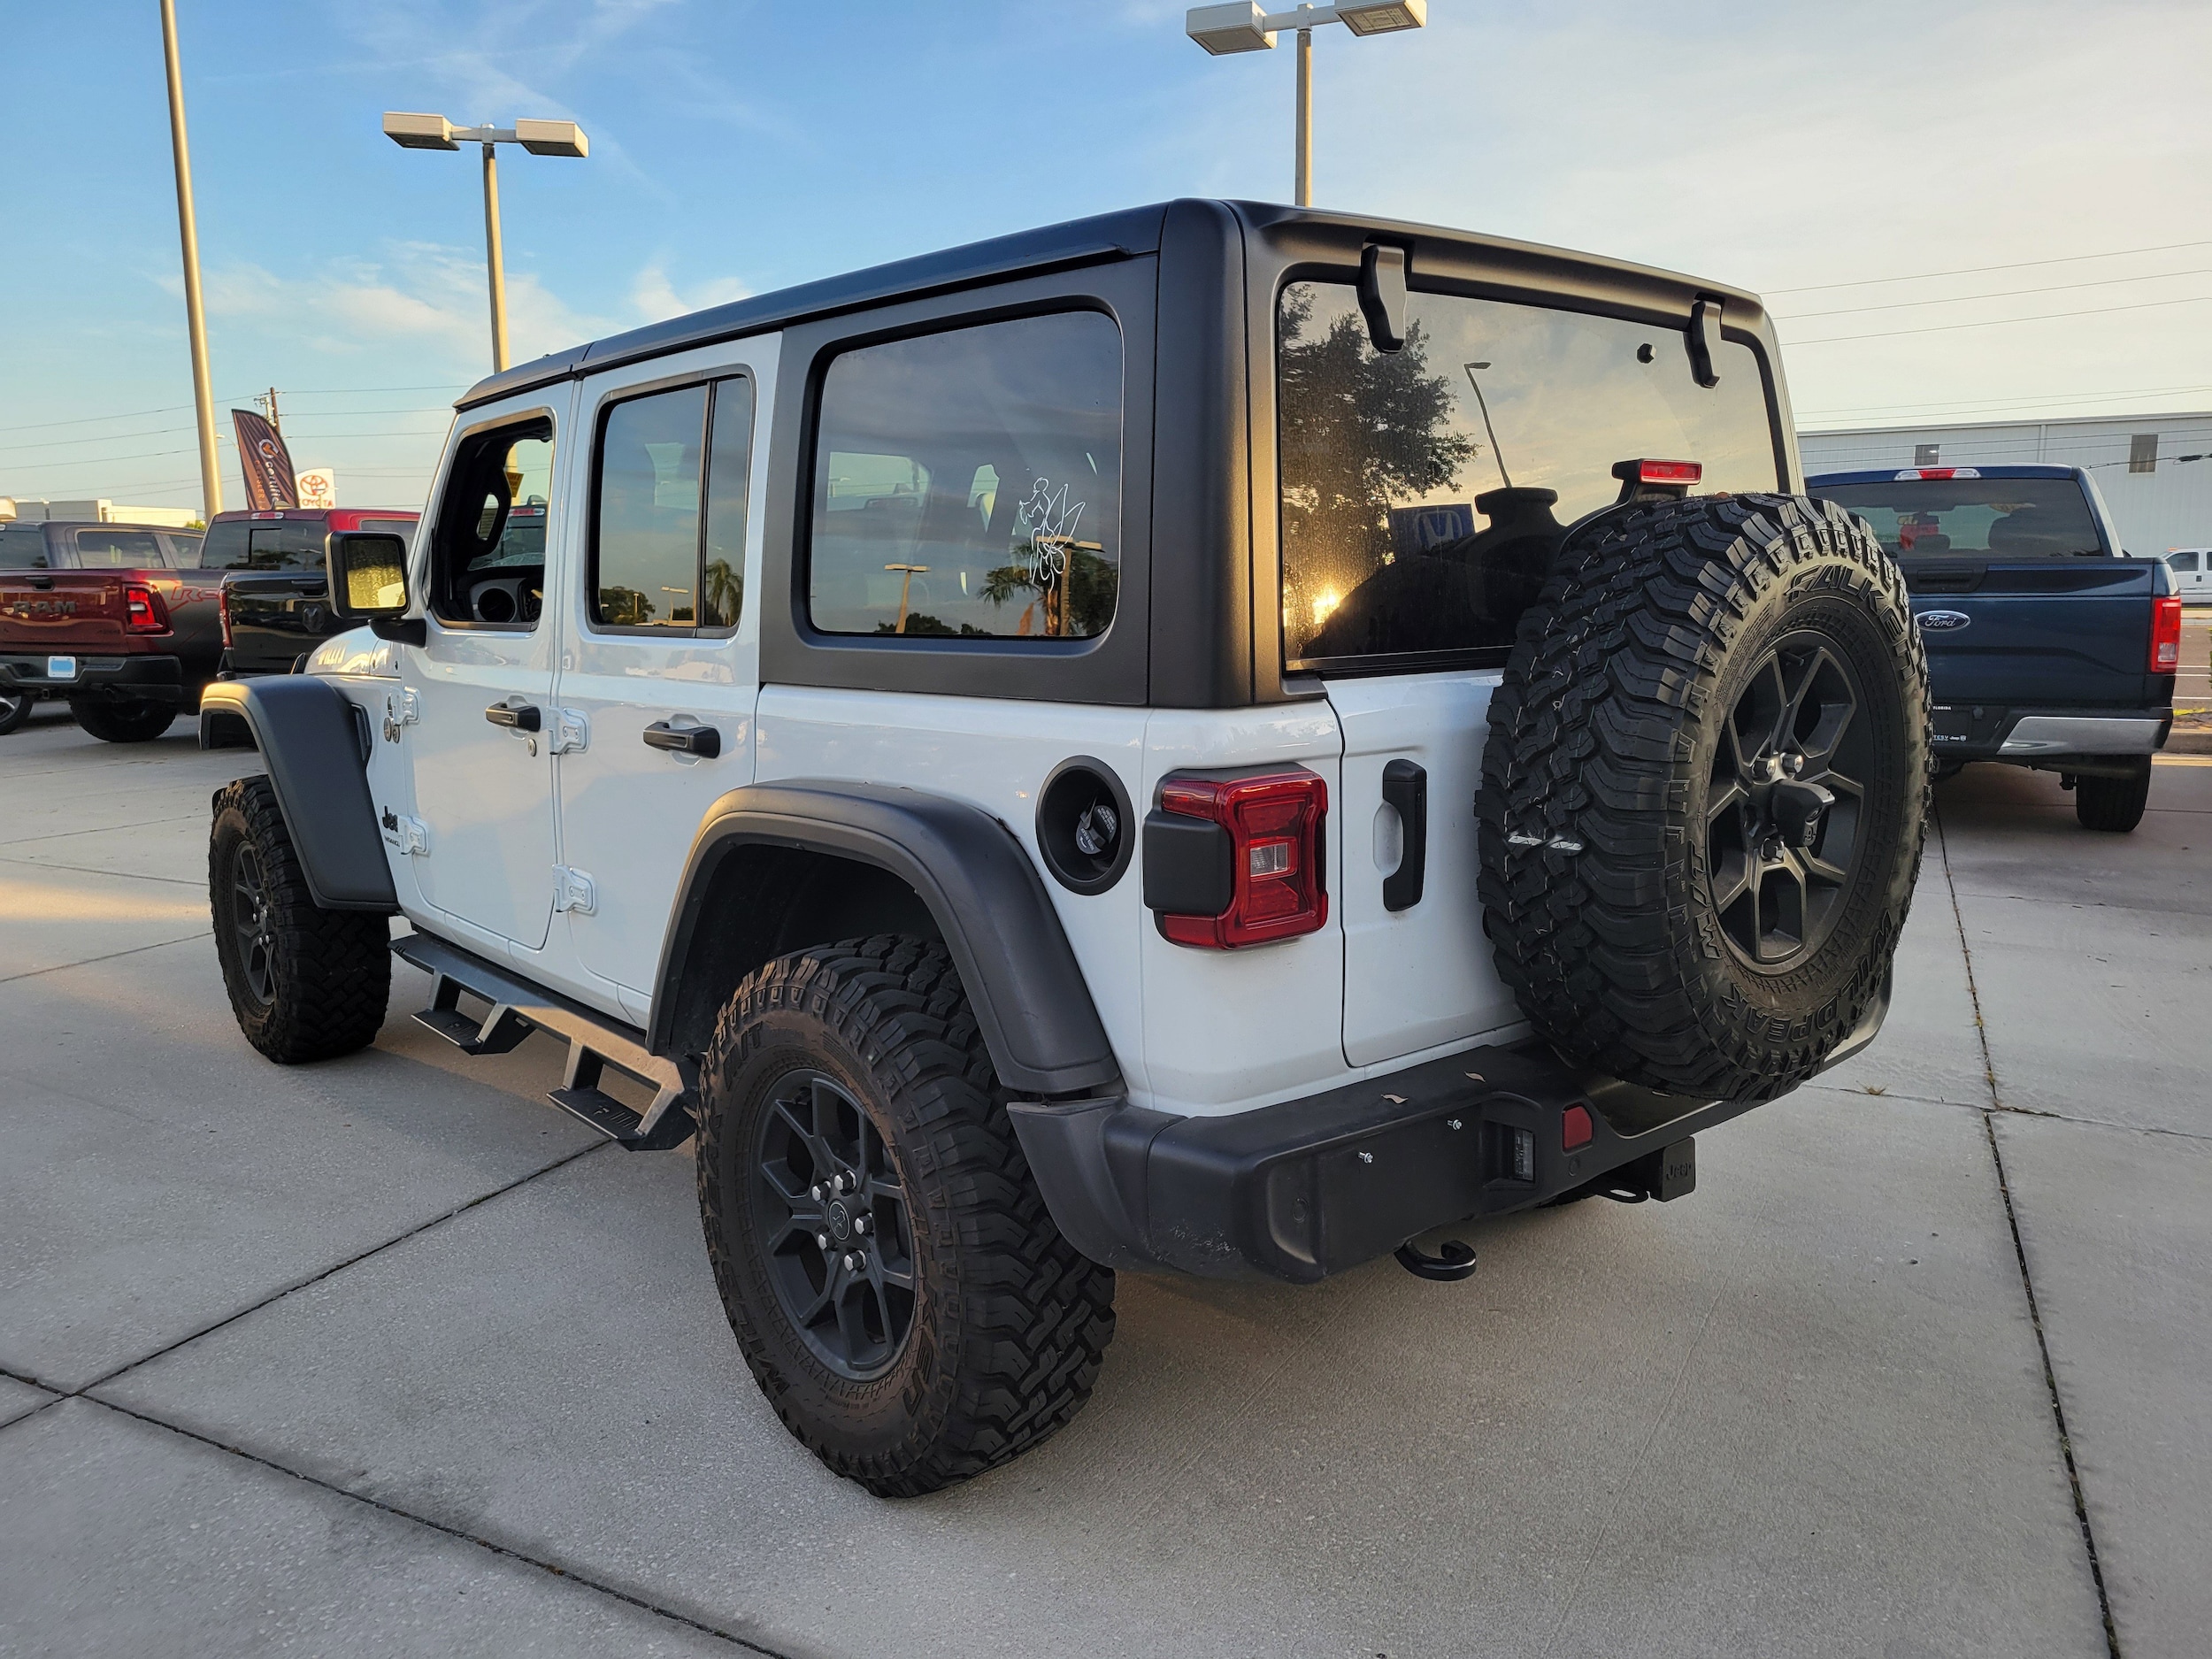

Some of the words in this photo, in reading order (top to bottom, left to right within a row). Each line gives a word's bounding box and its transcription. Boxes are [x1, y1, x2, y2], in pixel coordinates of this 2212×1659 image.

[265, 461, 280, 503] certifie
[301, 498, 334, 507] OYOTA
[13, 601, 76, 614] RAM
[1784, 563, 1916, 680] FALKEN
[1924, 614, 1957, 627] Ford
[1722, 908, 1893, 1044] WILDPEAK
[1666, 1162, 1692, 1180] Jeep
